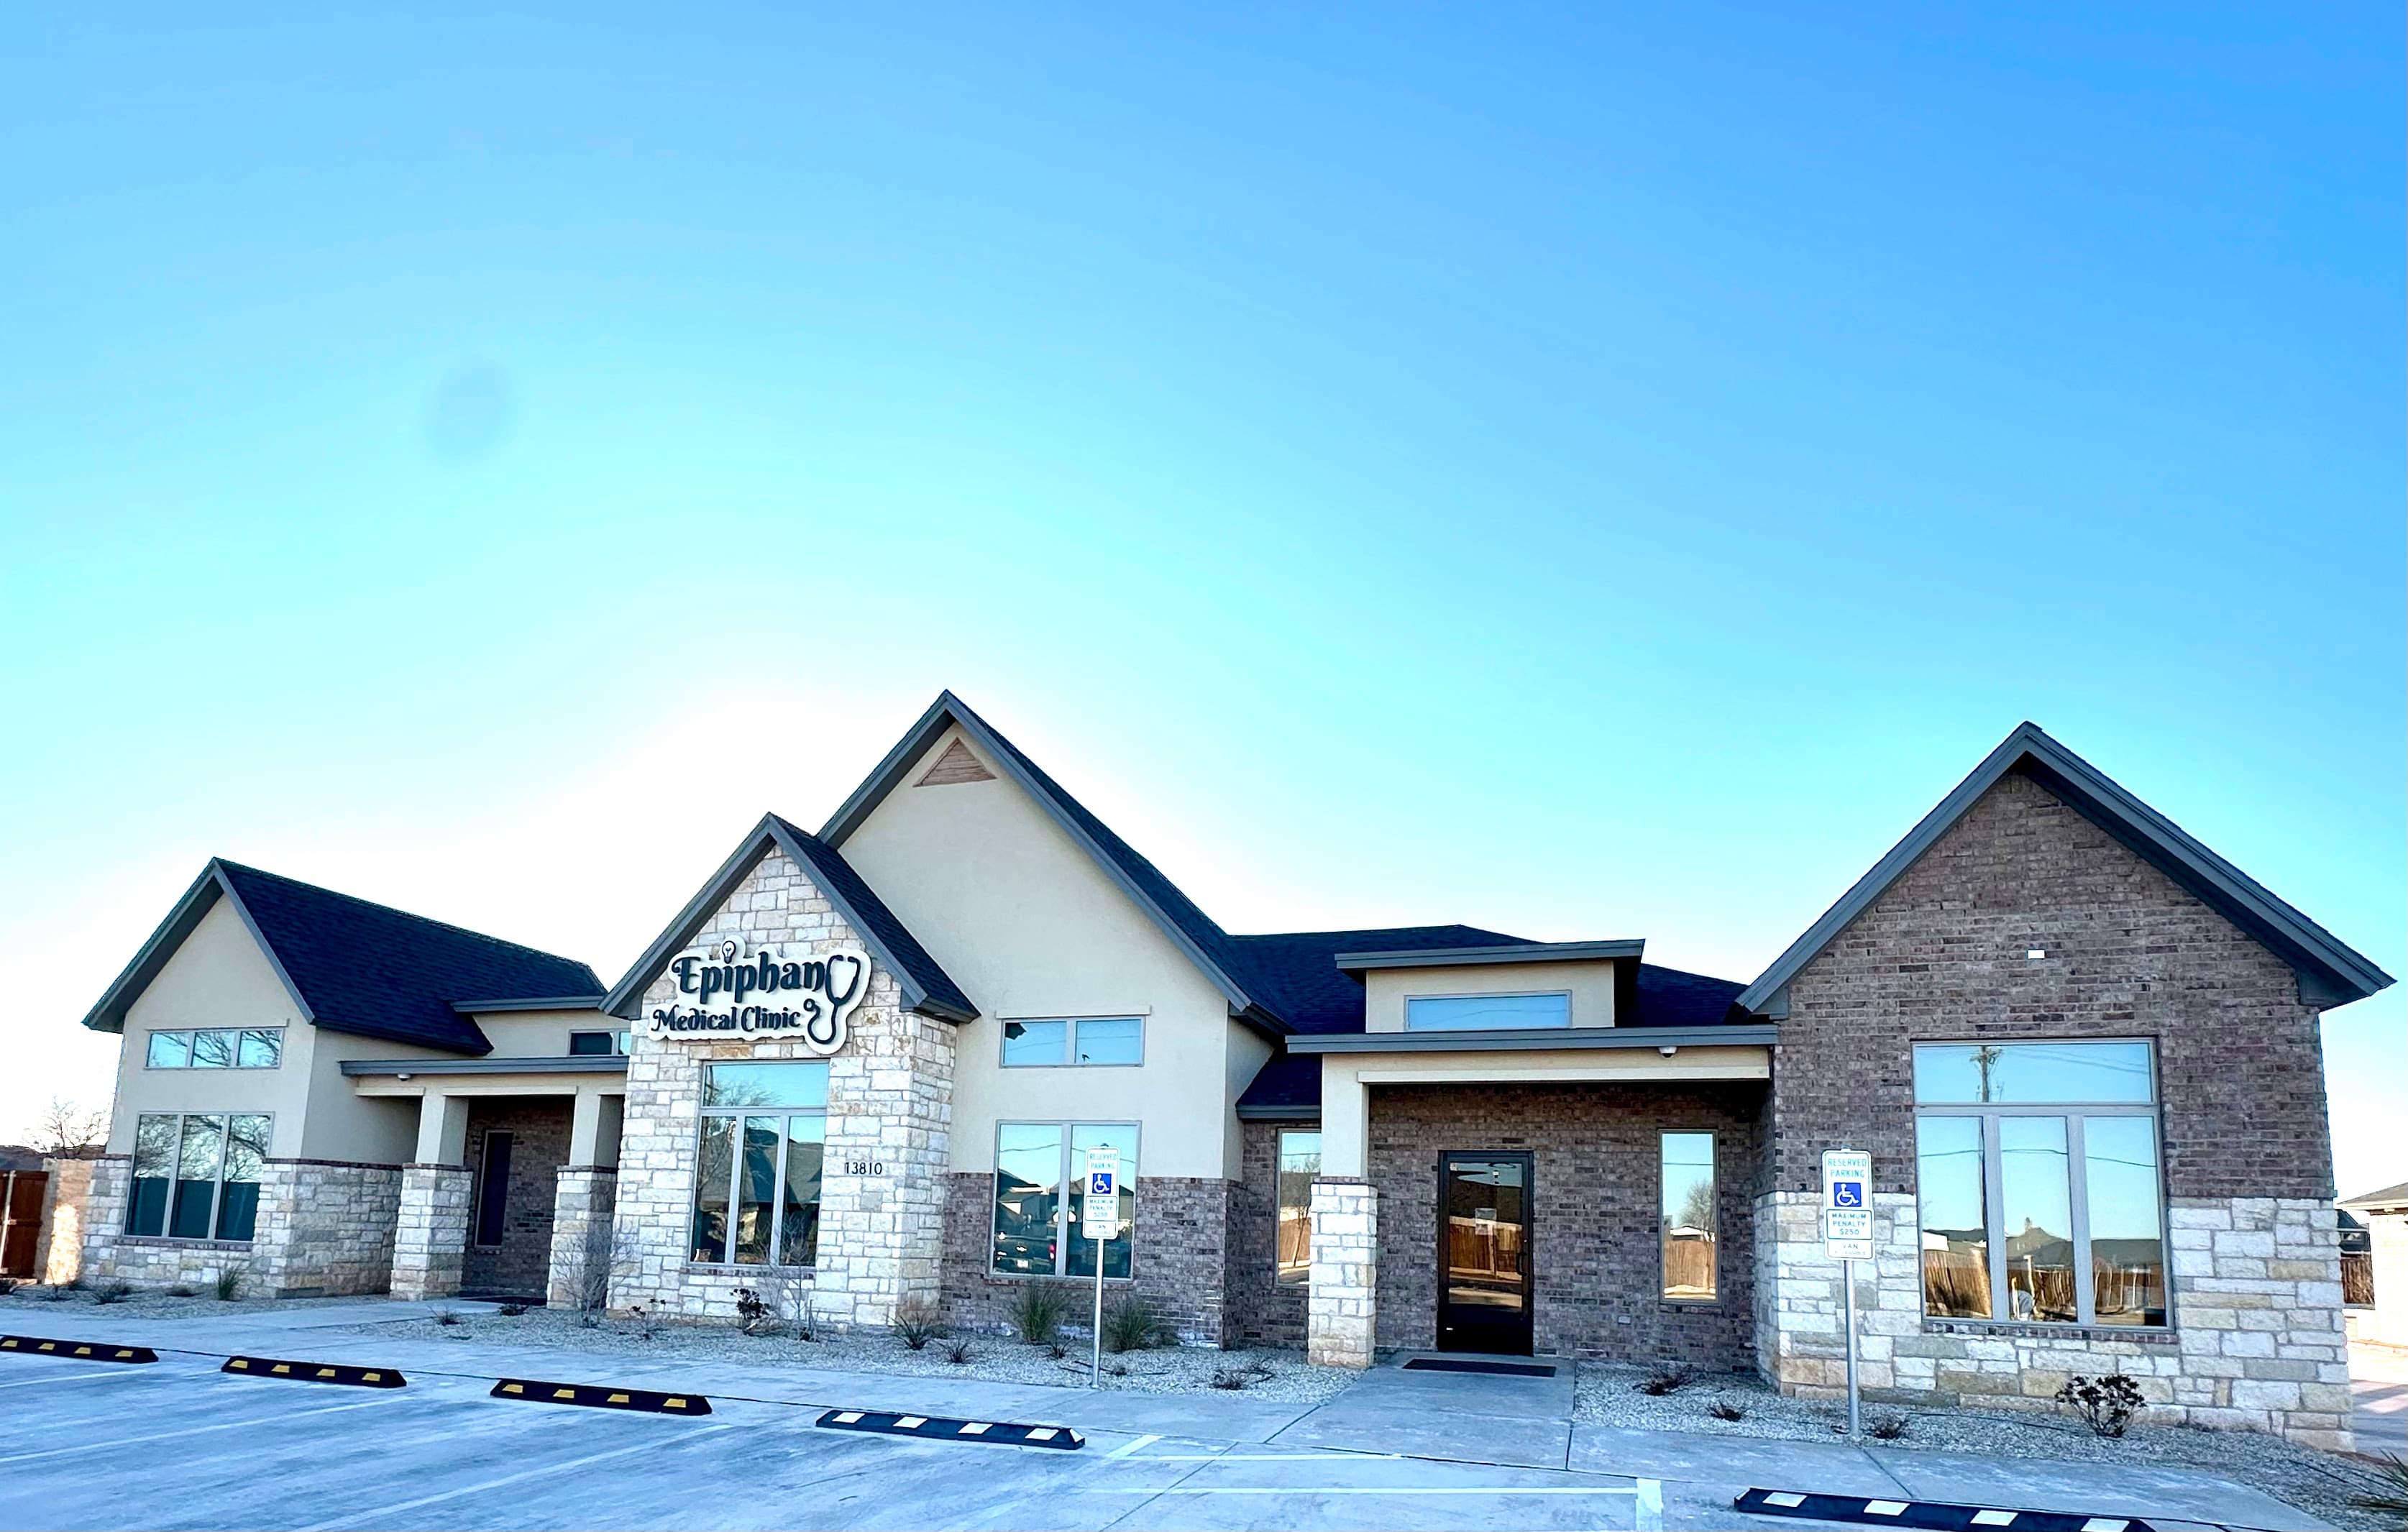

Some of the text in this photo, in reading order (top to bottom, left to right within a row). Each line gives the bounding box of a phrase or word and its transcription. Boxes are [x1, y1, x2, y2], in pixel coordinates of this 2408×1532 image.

[651, 1004, 801, 1032] Medical Clinic
[1827, 1157, 1867, 1167] RESERVED
[845, 1162, 883, 1175] 13810
[1830, 1169, 1865, 1178] PARKING
